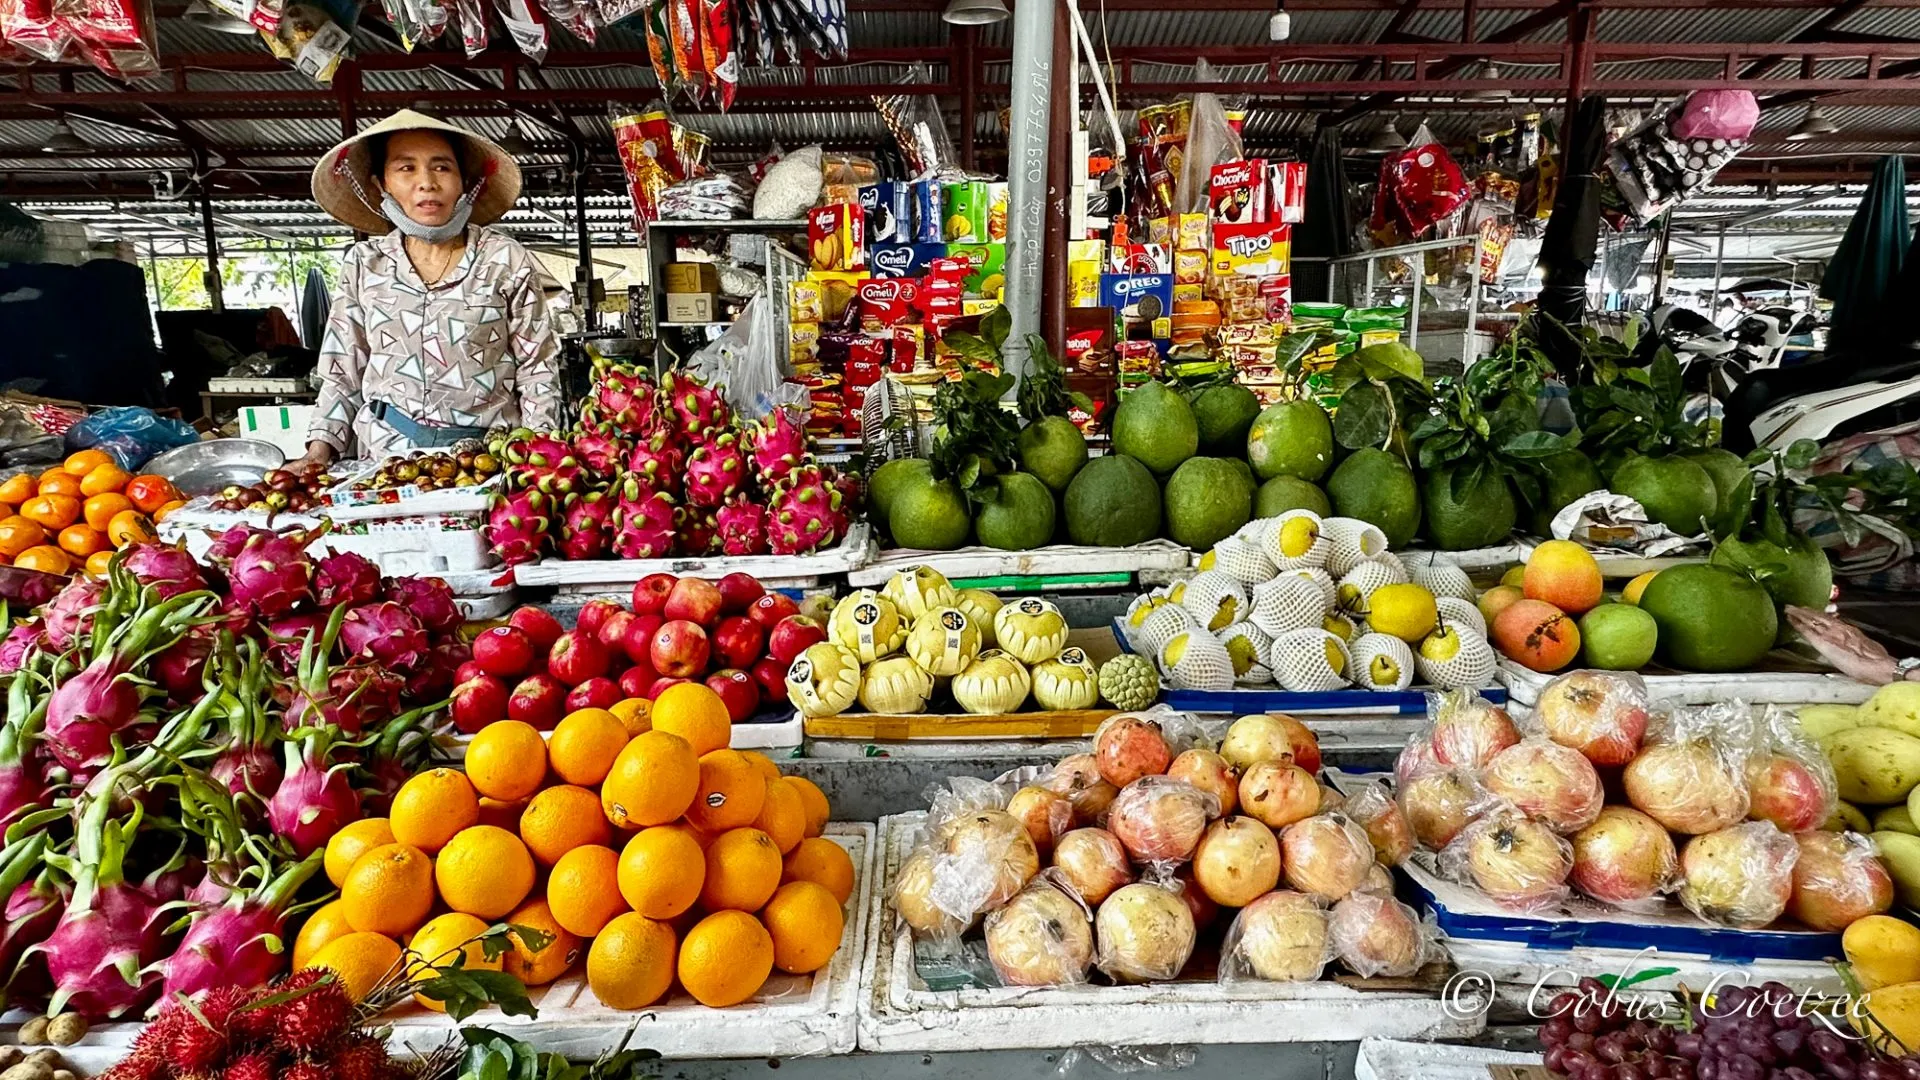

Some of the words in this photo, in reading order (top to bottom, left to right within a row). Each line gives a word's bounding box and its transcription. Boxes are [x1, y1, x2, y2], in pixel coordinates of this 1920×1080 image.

[1212, 171, 1250, 187] ChocoPie
[1226, 235, 1271, 257] Tipo
[1114, 277, 1161, 293] OREO
